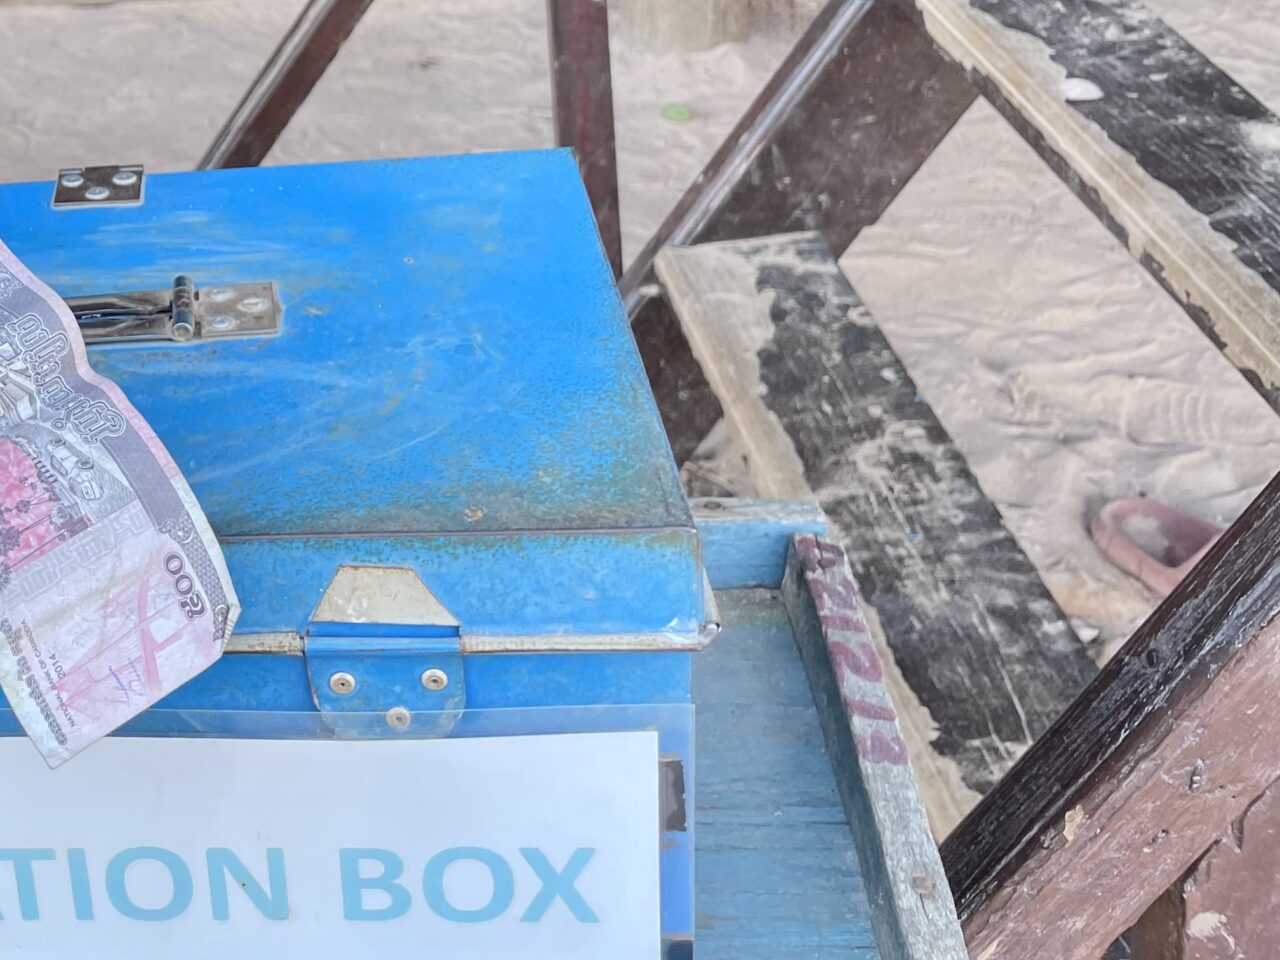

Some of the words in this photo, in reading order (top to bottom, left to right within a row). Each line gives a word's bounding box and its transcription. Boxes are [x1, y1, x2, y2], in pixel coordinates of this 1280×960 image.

[48, 653, 67, 679] 2014
[54, 691, 77, 727] NATIONAL
[338, 845, 602, 927] BOX
